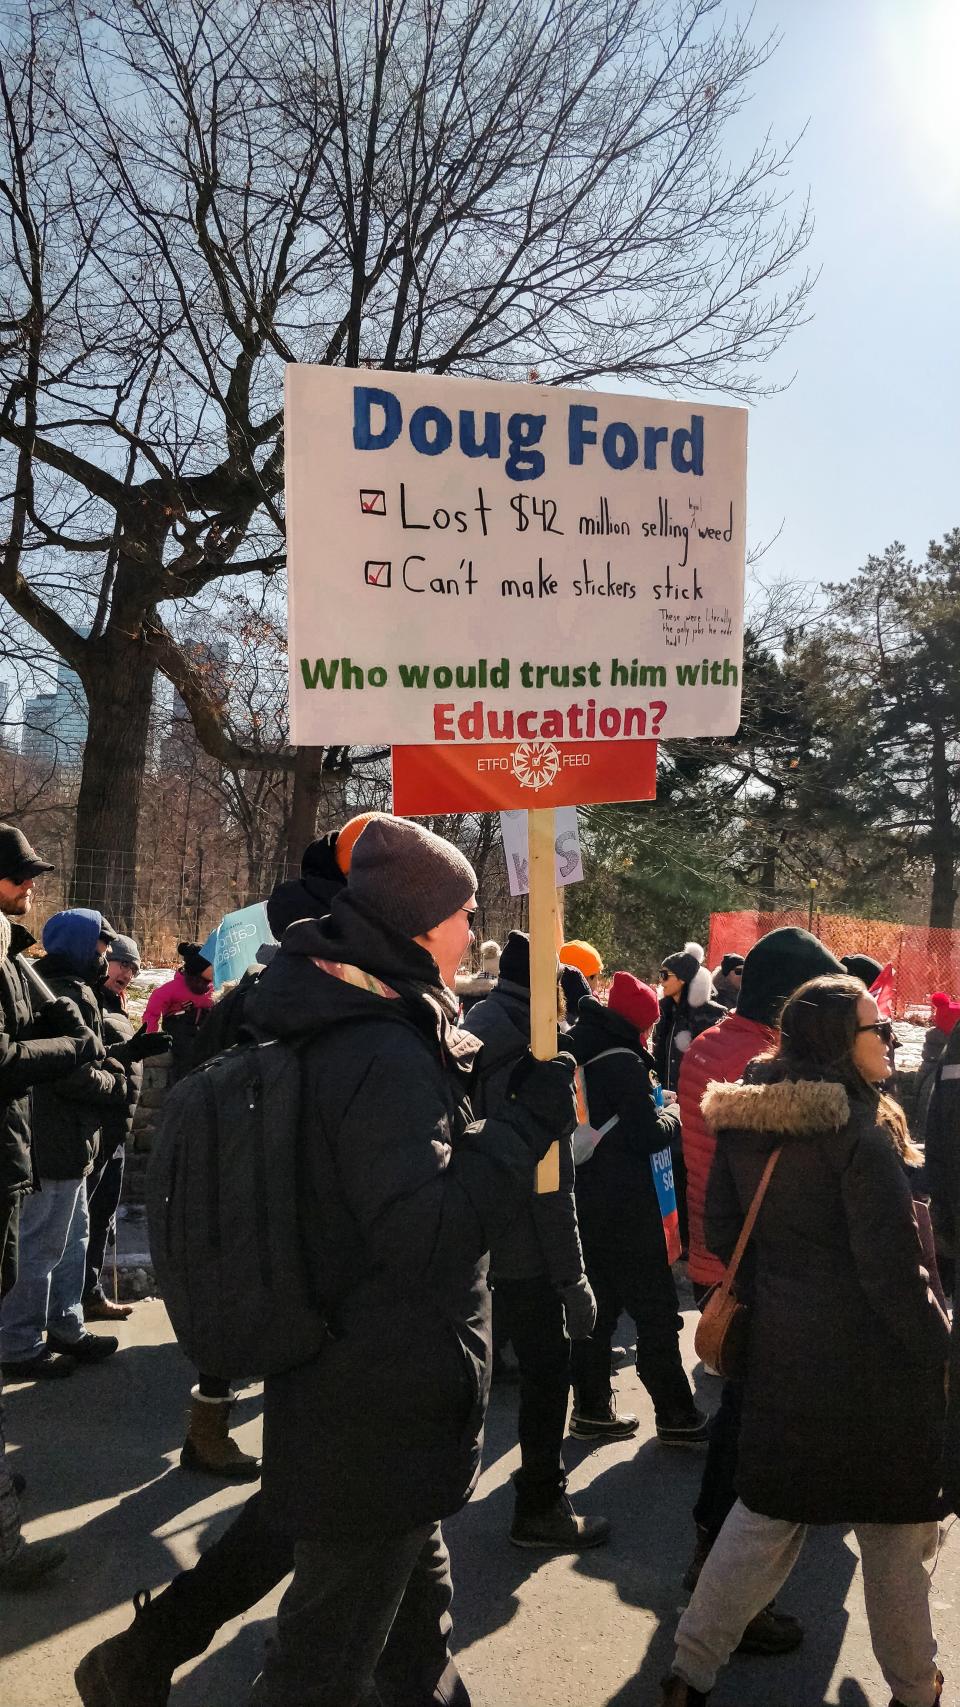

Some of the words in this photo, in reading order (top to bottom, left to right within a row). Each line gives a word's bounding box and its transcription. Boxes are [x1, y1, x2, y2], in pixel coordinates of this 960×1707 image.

[353, 386, 546, 481] Doug
[568, 404, 704, 476] Ford
[400, 483, 492, 536] Lost
[510, 493, 564, 536] $42
[579, 496, 630, 536] million
[642, 496, 689, 567] selling
[698, 501, 733, 542] weed
[403, 555, 478, 595] Can't
[502, 557, 558, 598] make
[573, 559, 636, 598] stickers
[653, 565, 703, 600] stick
[300, 657, 388, 689] Who
[398, 658, 510, 689] would
[519, 661, 601, 688] trust
[610, 658, 666, 687] him
[676, 658, 738, 687] with
[433, 699, 667, 740] Education?
[477, 757, 509, 771] ETFO
[562, 753, 590, 766] FEEO
